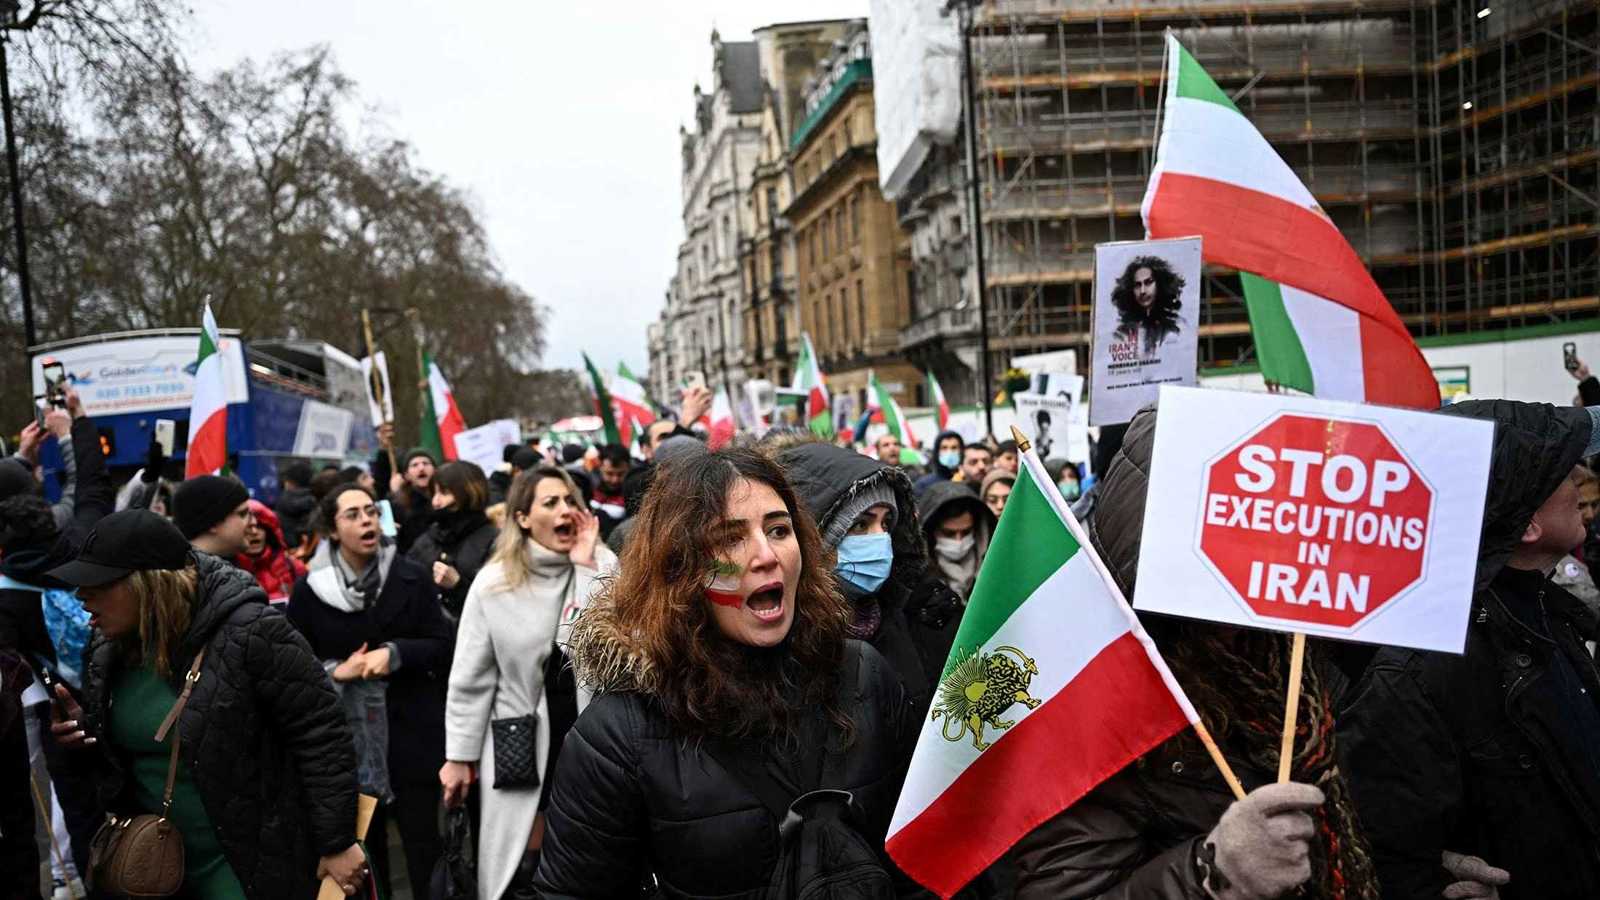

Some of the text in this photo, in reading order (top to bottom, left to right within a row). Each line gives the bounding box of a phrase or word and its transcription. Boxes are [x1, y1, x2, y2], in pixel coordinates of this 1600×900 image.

[1108, 342, 1138, 353] IRAN'S
[1111, 351, 1138, 361] VOICE
[1234, 444, 1410, 508] STOP
[1206, 493, 1424, 551] EXECUTIONS
[1297, 541, 1331, 566] IN
[1247, 561, 1370, 614] IRAN
